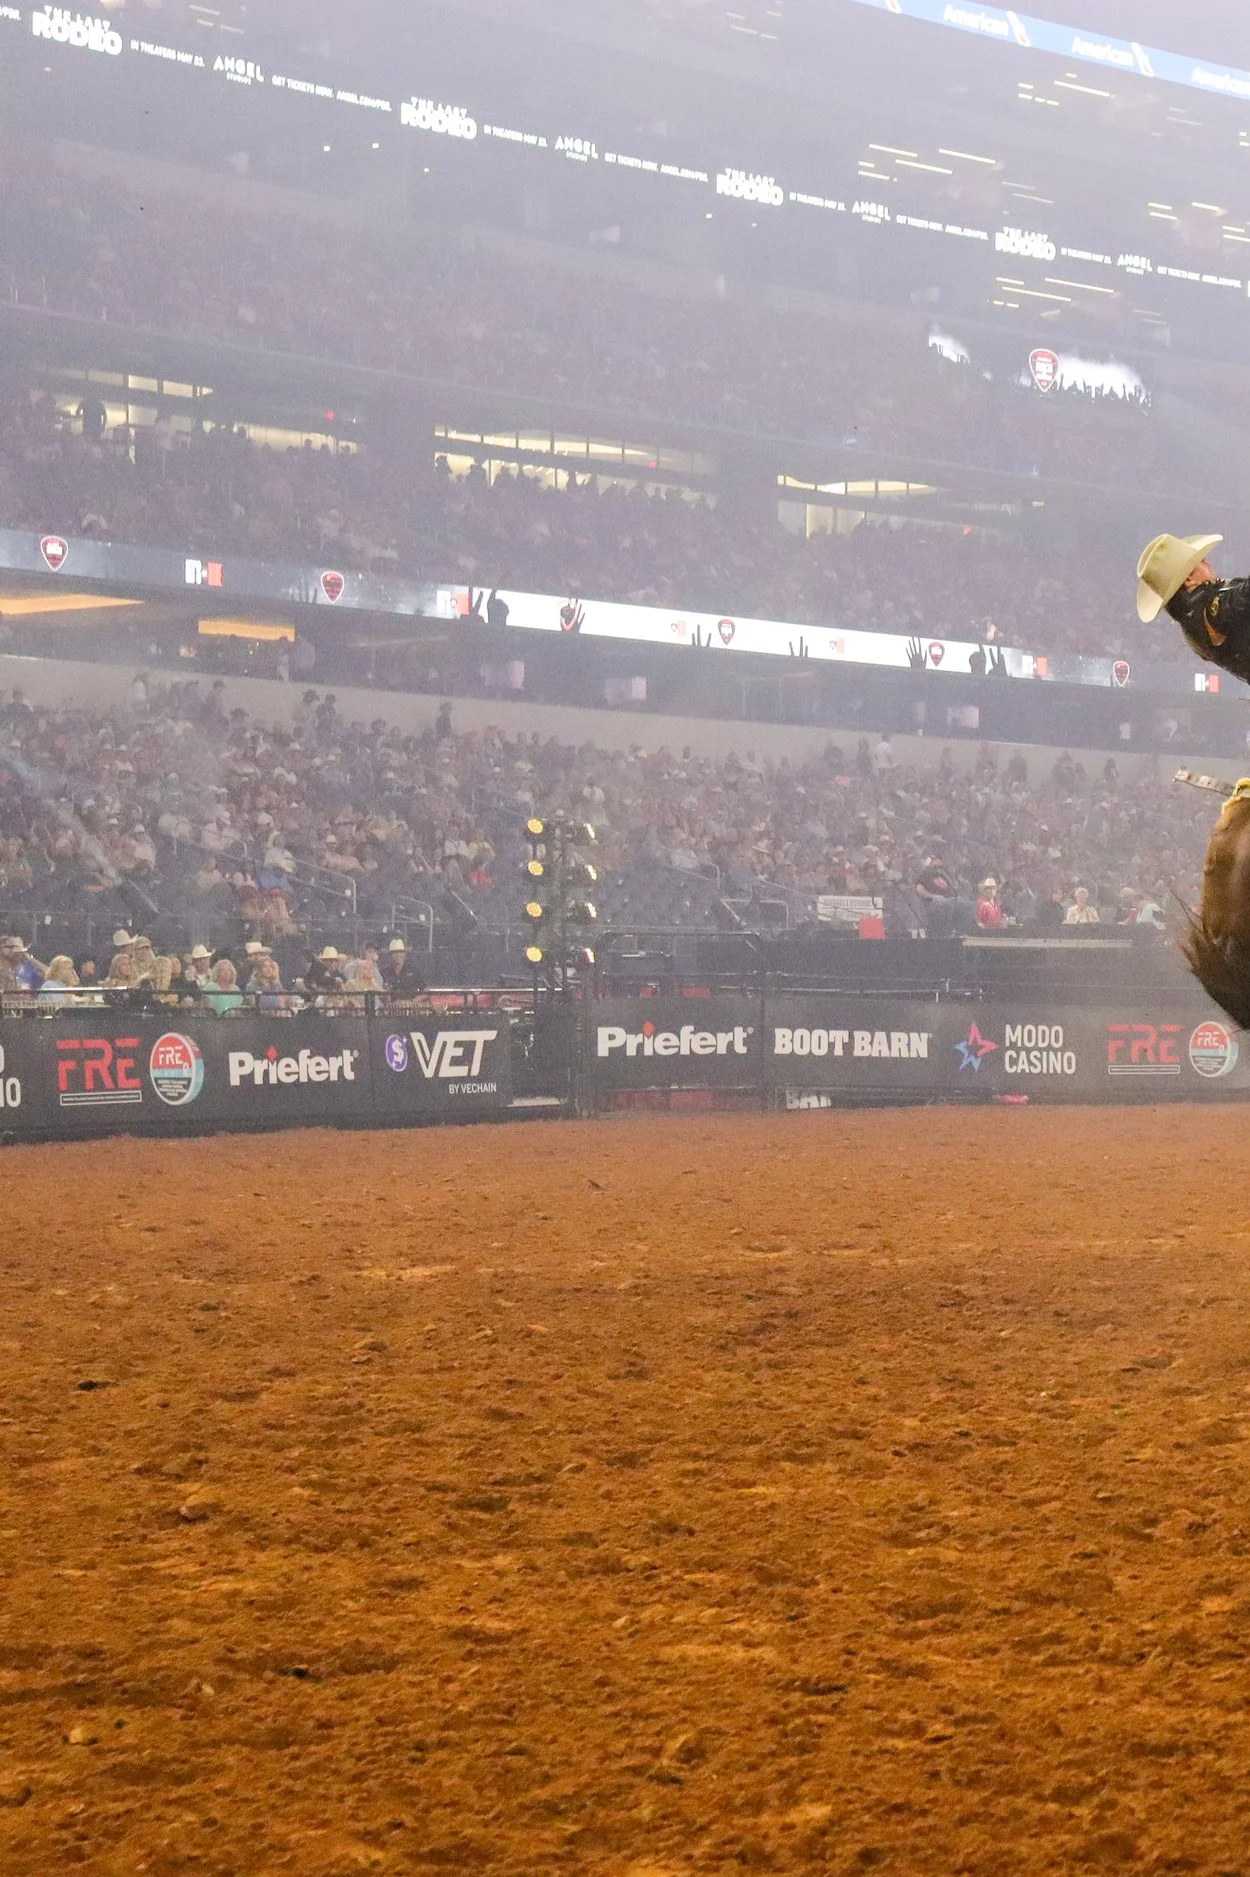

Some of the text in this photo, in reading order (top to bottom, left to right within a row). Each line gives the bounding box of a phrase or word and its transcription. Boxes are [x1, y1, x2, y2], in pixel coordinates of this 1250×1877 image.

[943, 4, 1008, 36] American
[33, 11, 122, 55] RODEO
[130, 39, 140, 51] IN
[140, 41, 176, 60] THEATERS
[1071, 37, 1133, 67] American
[213, 56, 264, 82] ANGEL
[272, 74, 286, 87] GET
[287, 78, 315, 94] TICKETS
[555, 136, 598, 159] ANGEL
[852, 201, 891, 221] ANGEL
[1117, 254, 1152, 272] ANGEL
[597, 1020, 748, 1057] Priefert
[774, 1028, 929, 1058] BOOT BARN
[1005, 1024, 1064, 1048] MODO
[1107, 1024, 1182, 1064] FRE
[1197, 1031, 1220, 1047] FRE
[56, 1037, 141, 1091] FRE
[159, 1045, 183, 1065] FRE
[228, 1045, 355, 1086] Priefert
[410, 1030, 498, 1078] VET
[1004, 1051, 1076, 1074] CASINO
[449, 1083, 497, 1094] BY VECHAIN
